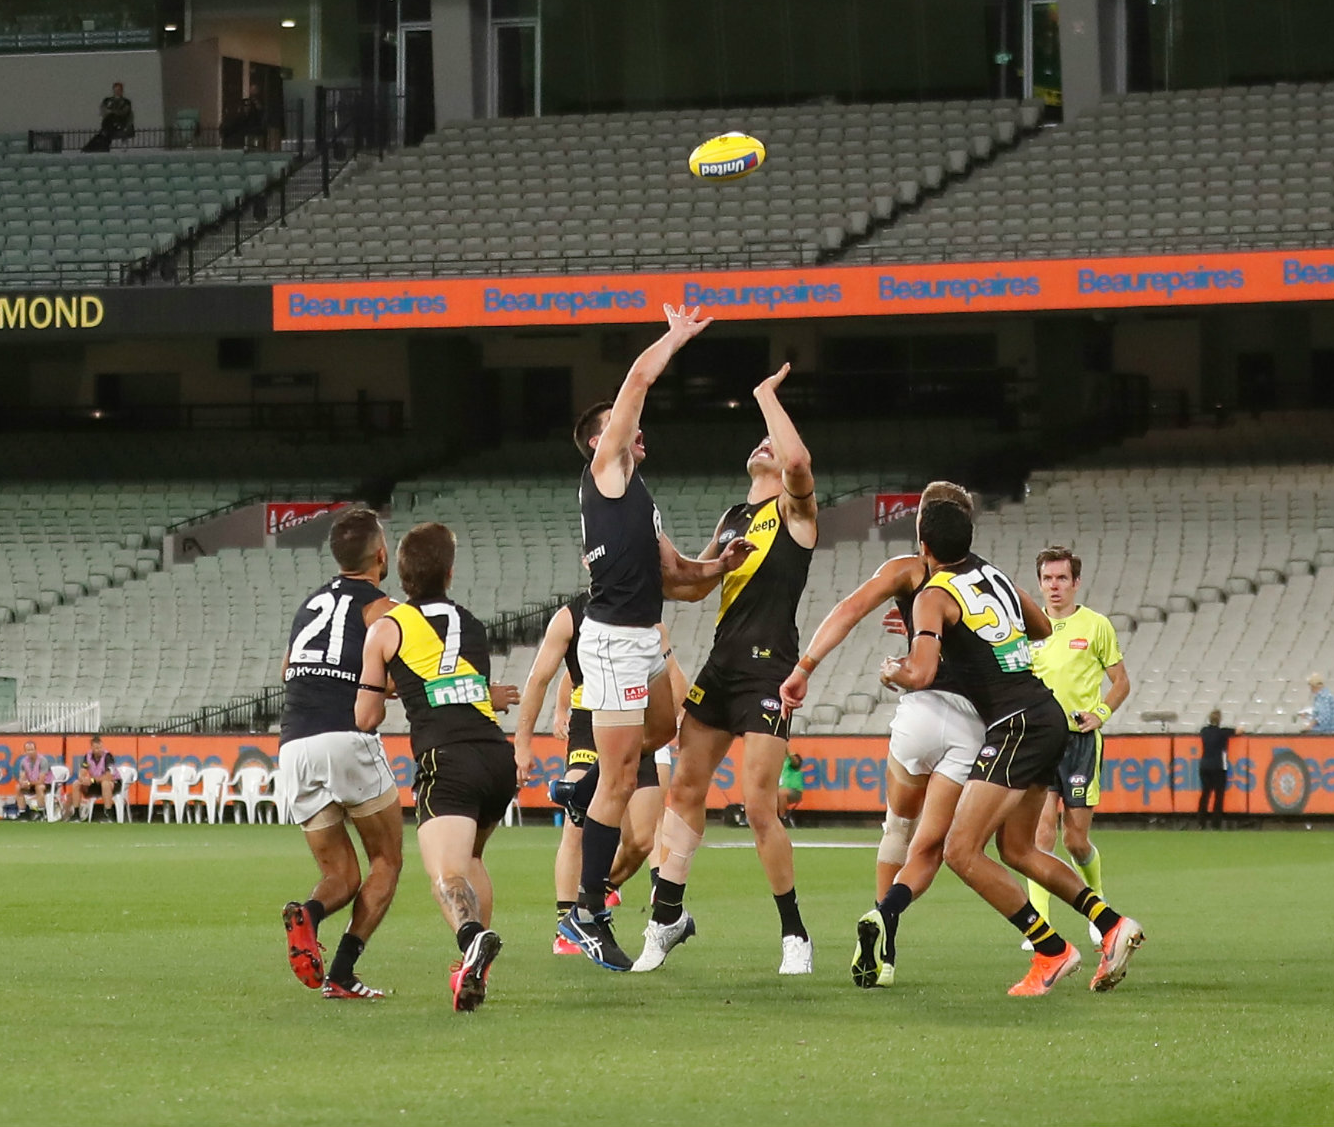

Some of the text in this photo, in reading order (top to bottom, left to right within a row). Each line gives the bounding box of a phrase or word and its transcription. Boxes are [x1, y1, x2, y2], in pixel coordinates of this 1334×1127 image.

[701, 160, 745, 176] United
[289, 293, 447, 320] Beaurepaires
[483, 288, 646, 315] Beaurepaires
[684, 282, 842, 310] Beaurepaires
[878, 276, 1040, 302] Beaurepaires
[1078, 268, 1244, 296] Beaurepaires
[749, 518, 776, 534] Jeep
[950, 564, 1025, 643] 50
[289, 592, 354, 665] 21
[420, 602, 461, 674] 7
[433, 677, 487, 705] nib
[1069, 776, 1086, 785] AFL
